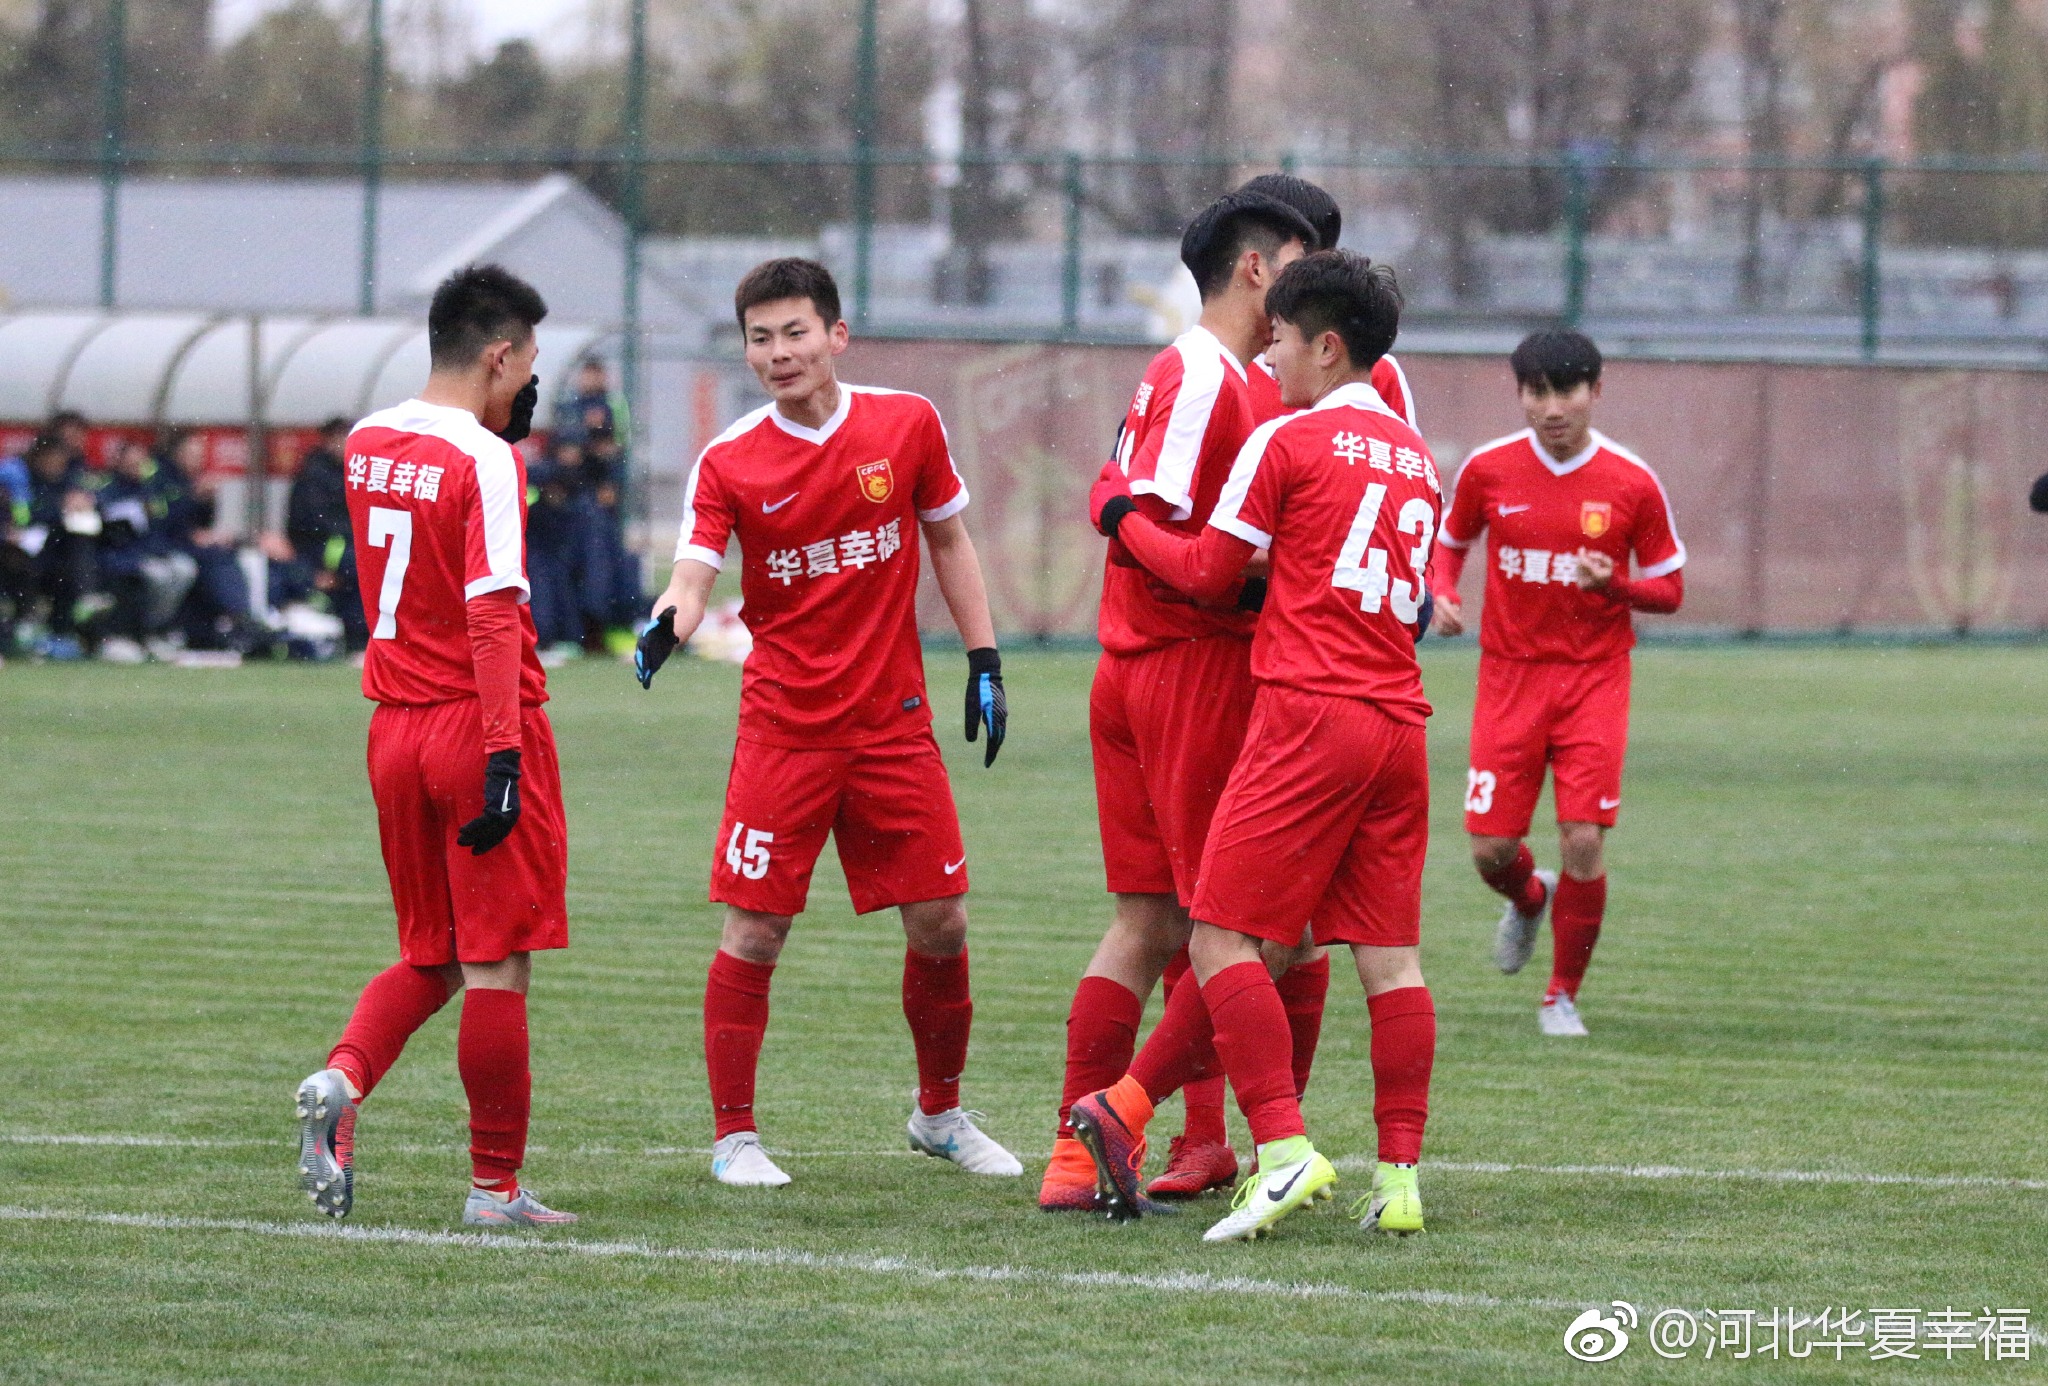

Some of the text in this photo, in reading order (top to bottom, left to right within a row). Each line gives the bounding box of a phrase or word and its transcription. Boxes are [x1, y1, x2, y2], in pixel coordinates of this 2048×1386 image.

[347, 453, 445, 502] 华夏幸福
[367, 505, 413, 640] 7
[765, 516, 902, 587] 华夏幸福
[1331, 482, 1435, 625] 43
[1498, 545, 1581, 588] 华夏幸
[726, 821, 774, 880] 45
